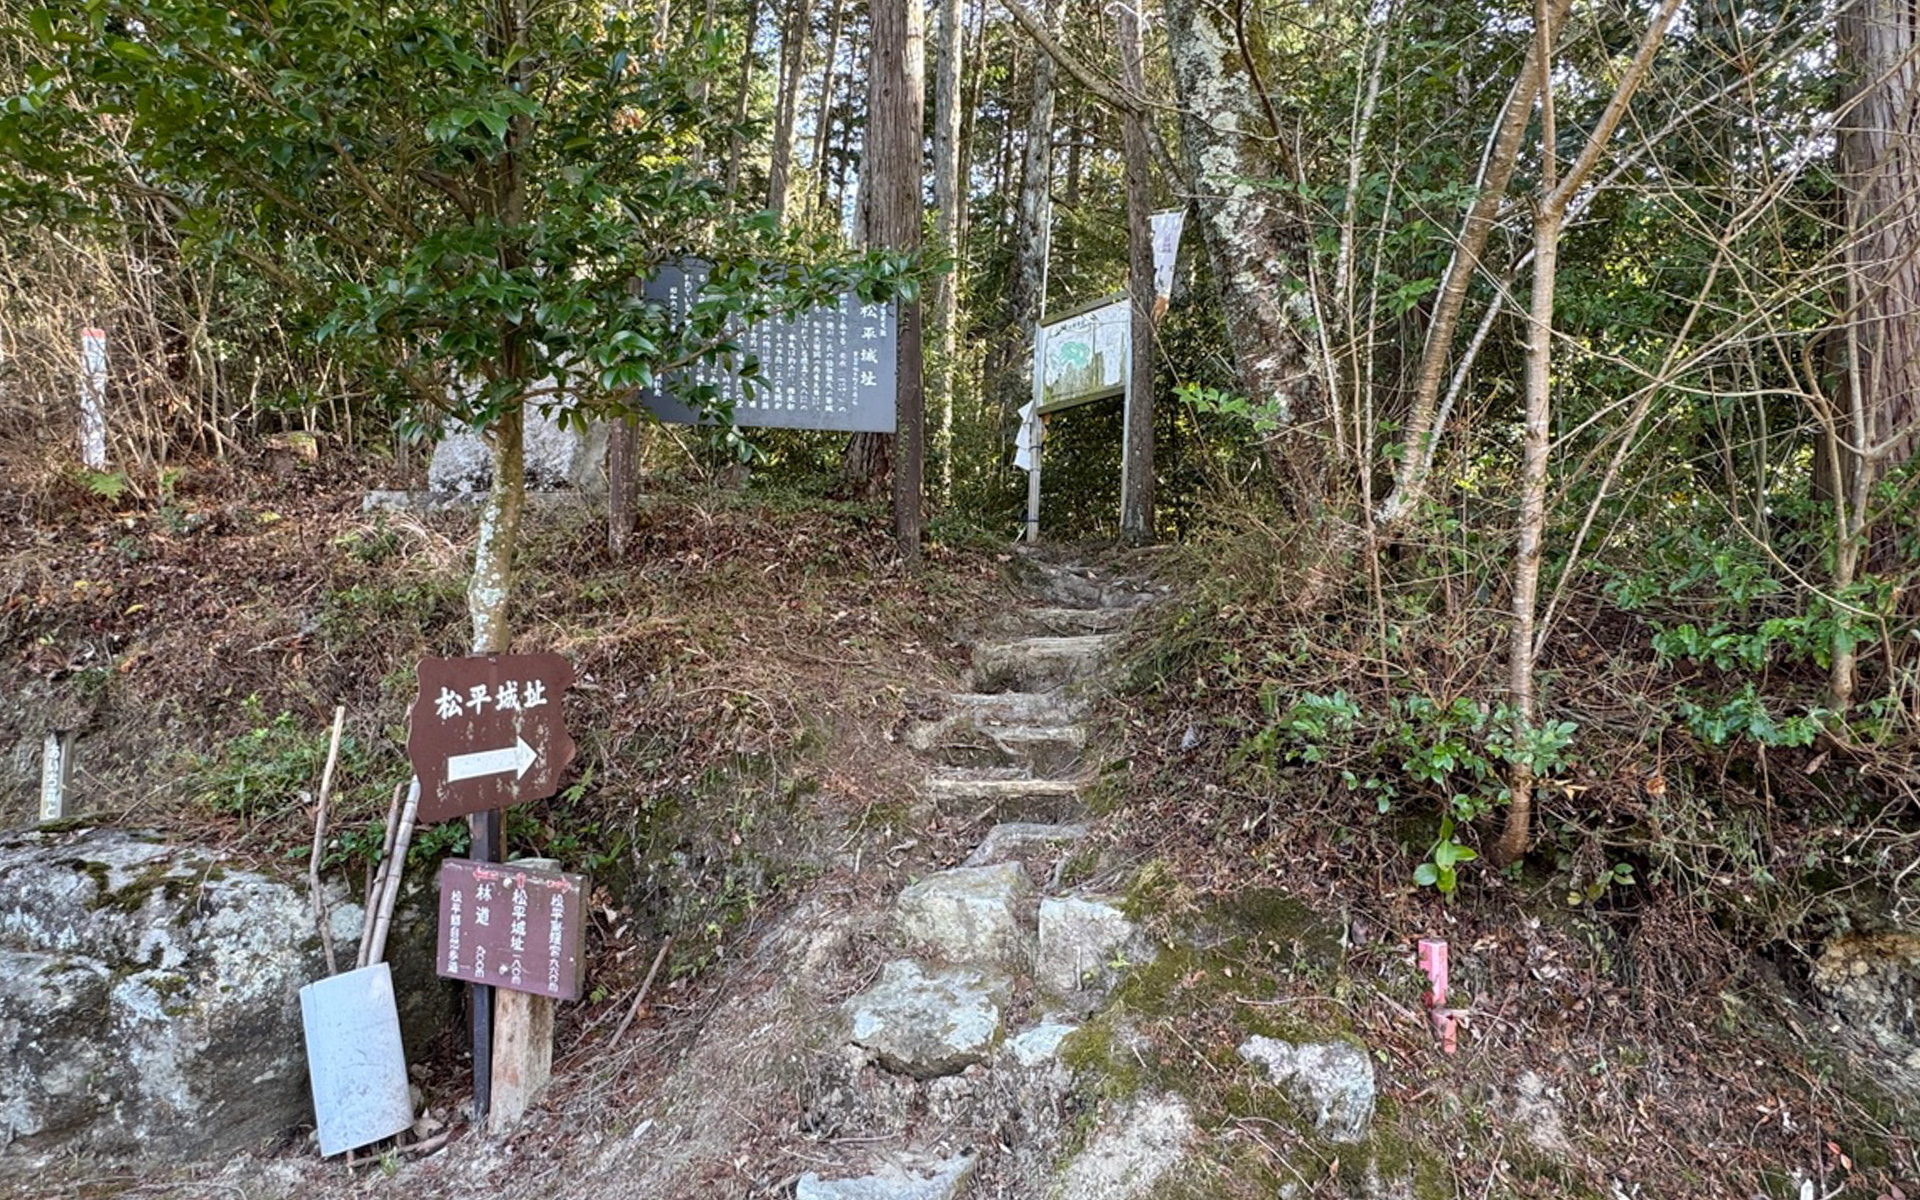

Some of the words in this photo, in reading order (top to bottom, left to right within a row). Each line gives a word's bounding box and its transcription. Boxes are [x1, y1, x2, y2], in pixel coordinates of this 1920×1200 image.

[860, 304, 878, 387] 松平城址
[434, 679, 548, 720] 松平城址
[474, 883, 493, 926] 林道
